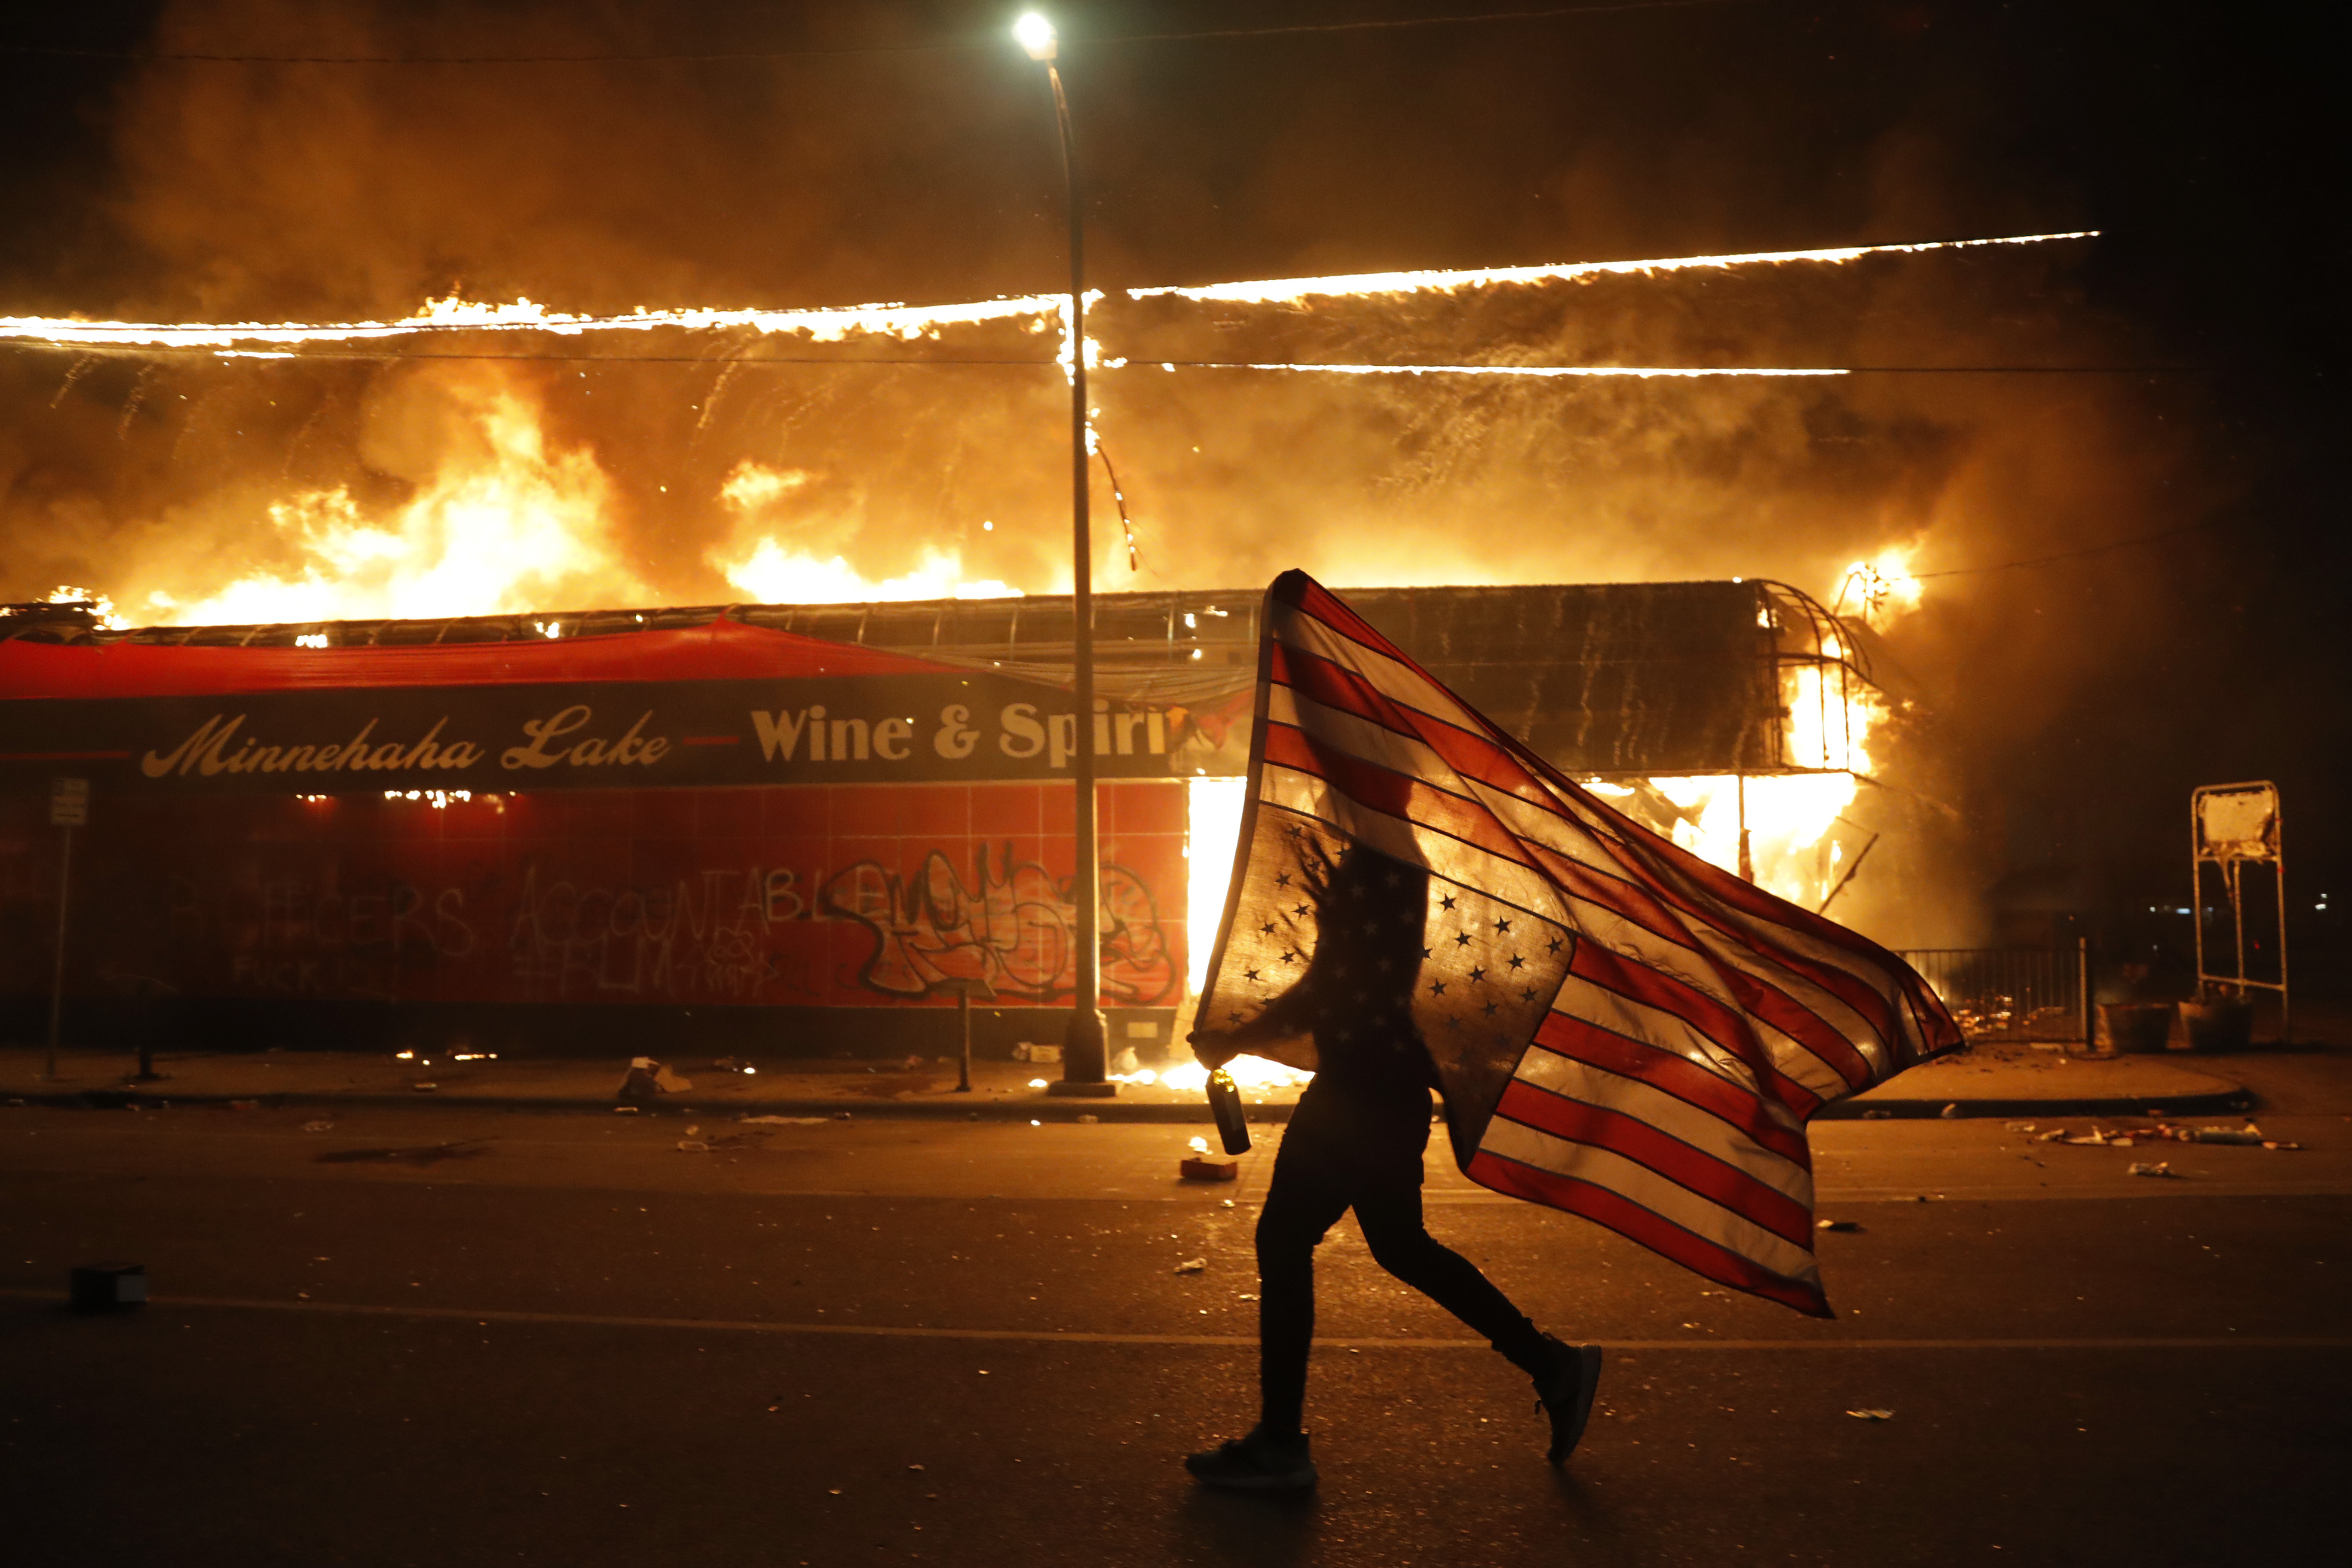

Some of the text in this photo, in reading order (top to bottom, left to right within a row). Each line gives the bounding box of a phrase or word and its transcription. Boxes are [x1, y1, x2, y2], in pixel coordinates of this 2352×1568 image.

[141, 713, 486, 778] Minnehaha
[500, 704, 671, 769] Lake
[750, 704, 913, 762] Wine
[934, 704, 980, 759] &
